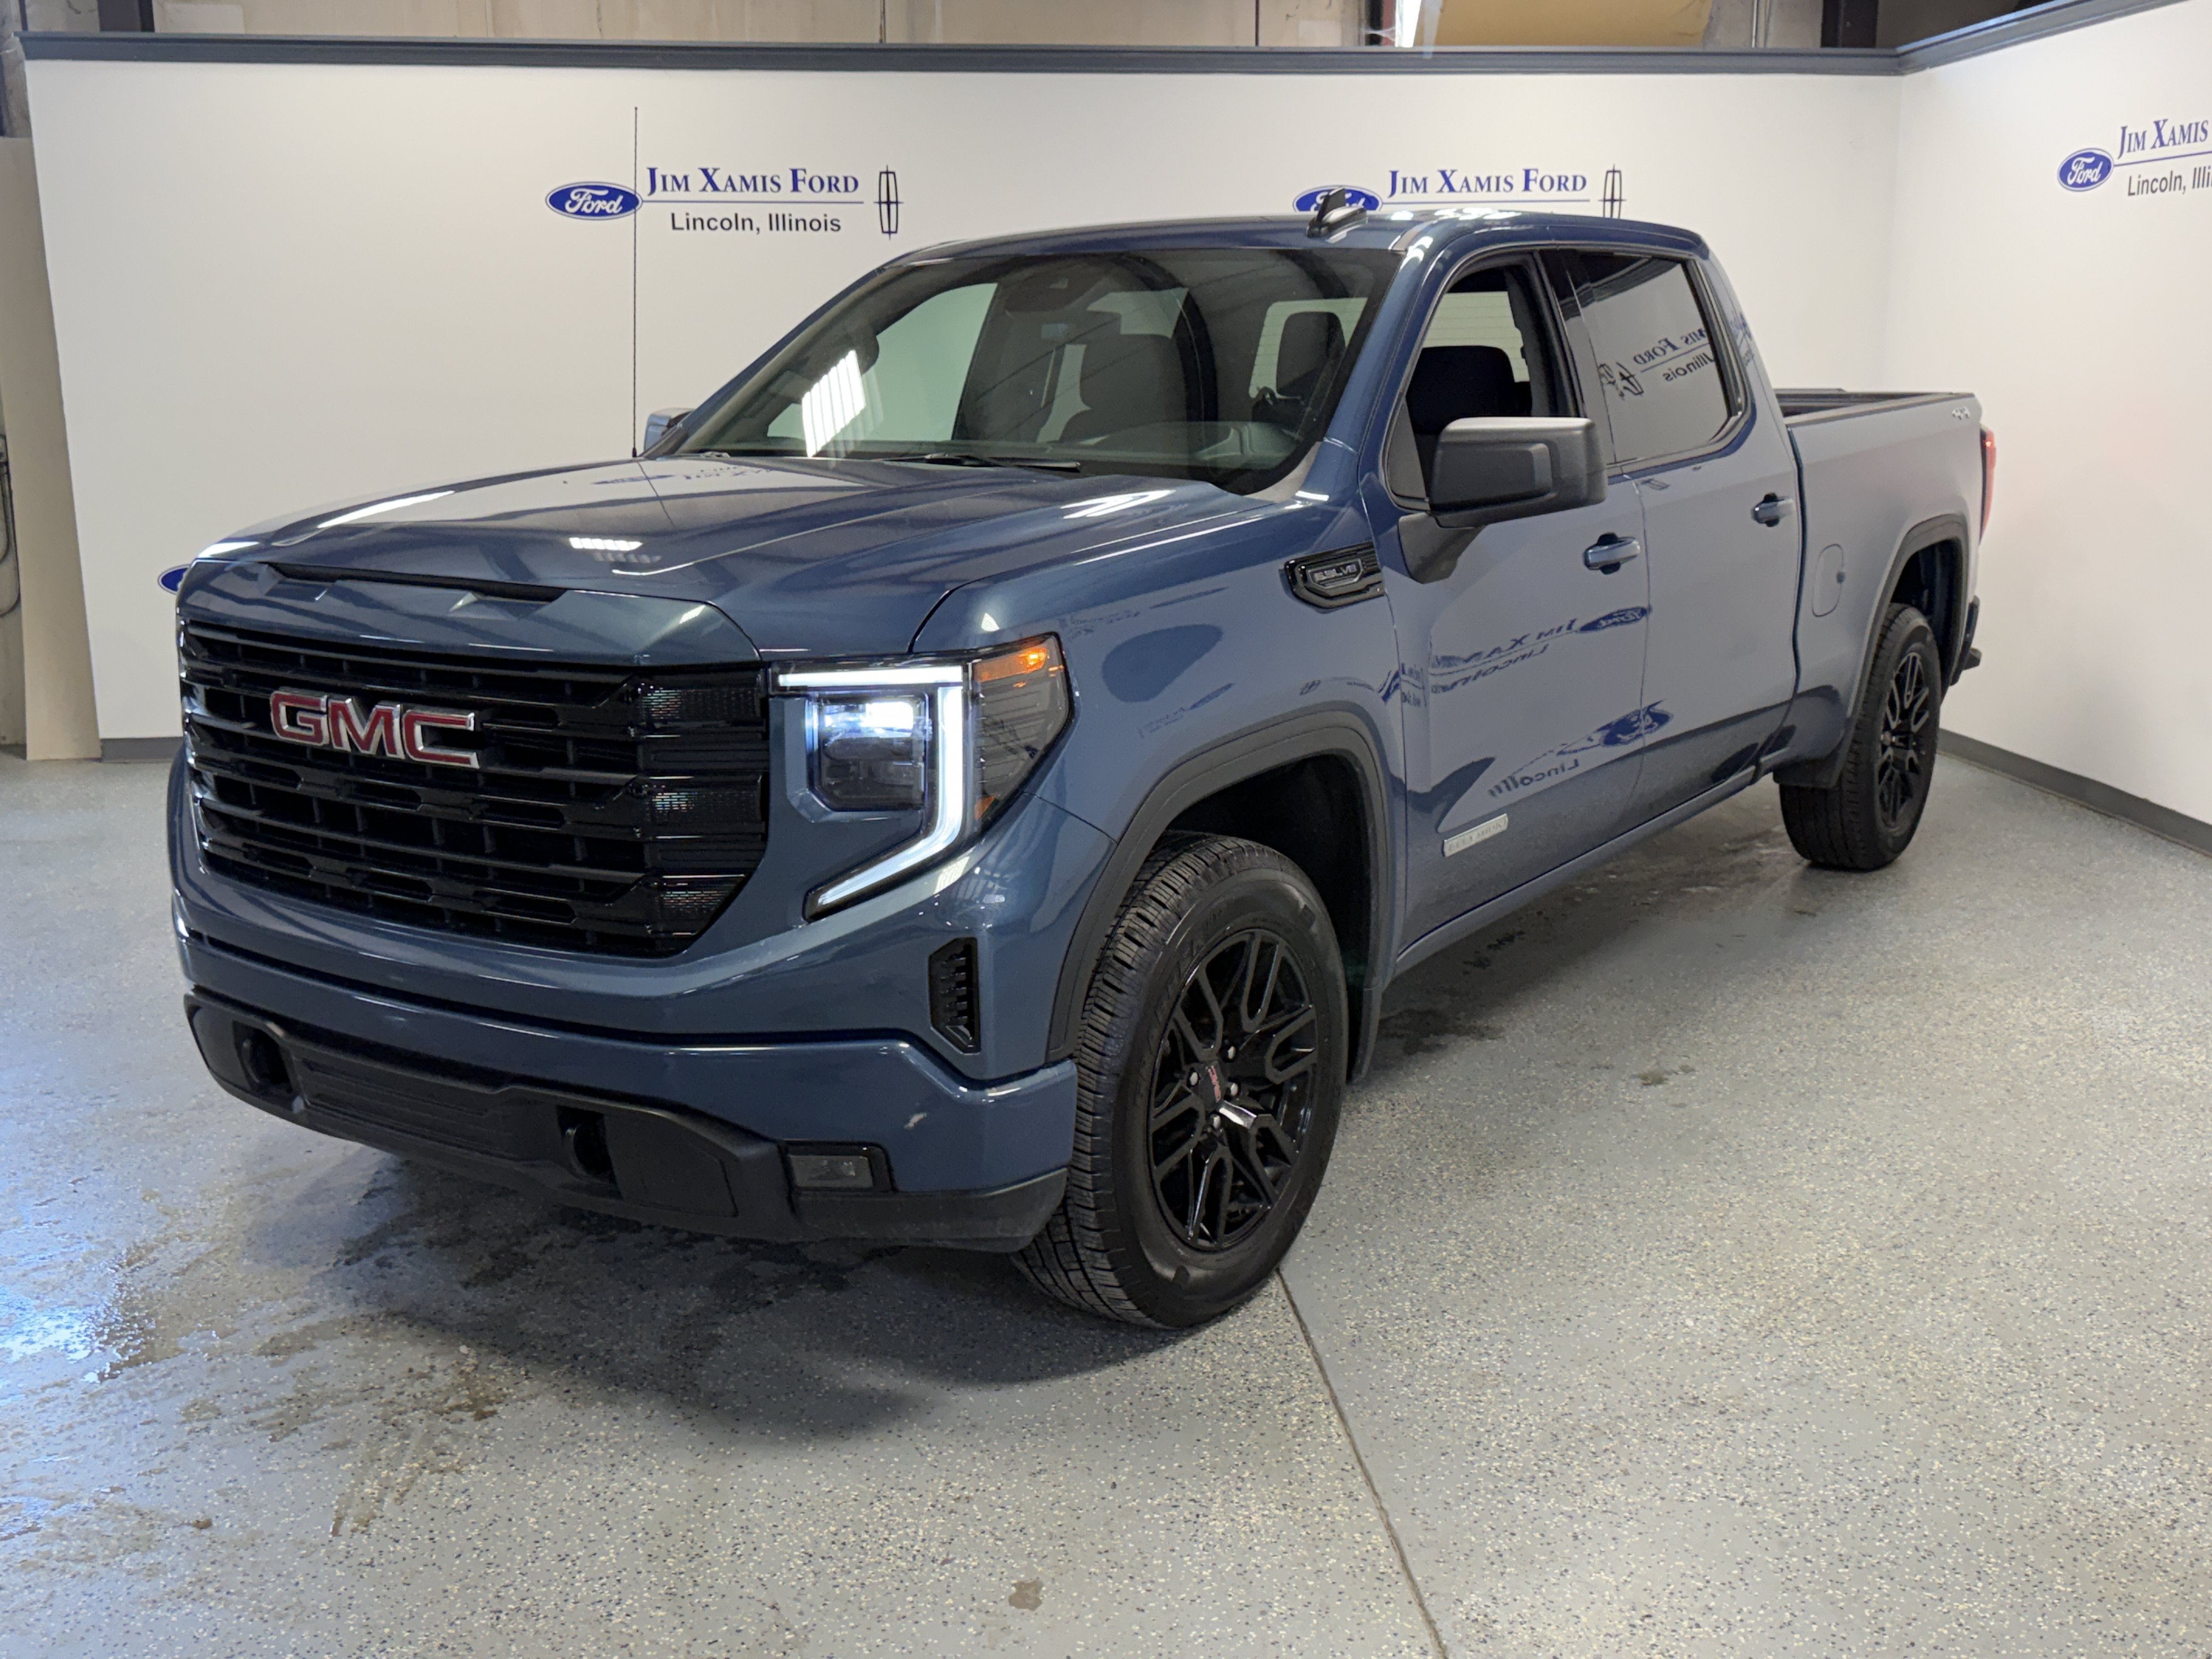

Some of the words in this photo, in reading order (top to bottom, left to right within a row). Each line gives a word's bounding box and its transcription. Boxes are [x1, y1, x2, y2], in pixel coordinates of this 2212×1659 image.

[2067, 157, 2104, 185] Ford
[2128, 171, 2186, 196] Lincoln,
[565, 188, 623, 214] Ford
[671, 212, 760, 235] Lincoln,
[768, 213, 842, 233] Illinois
[269, 688, 480, 769] GMC
